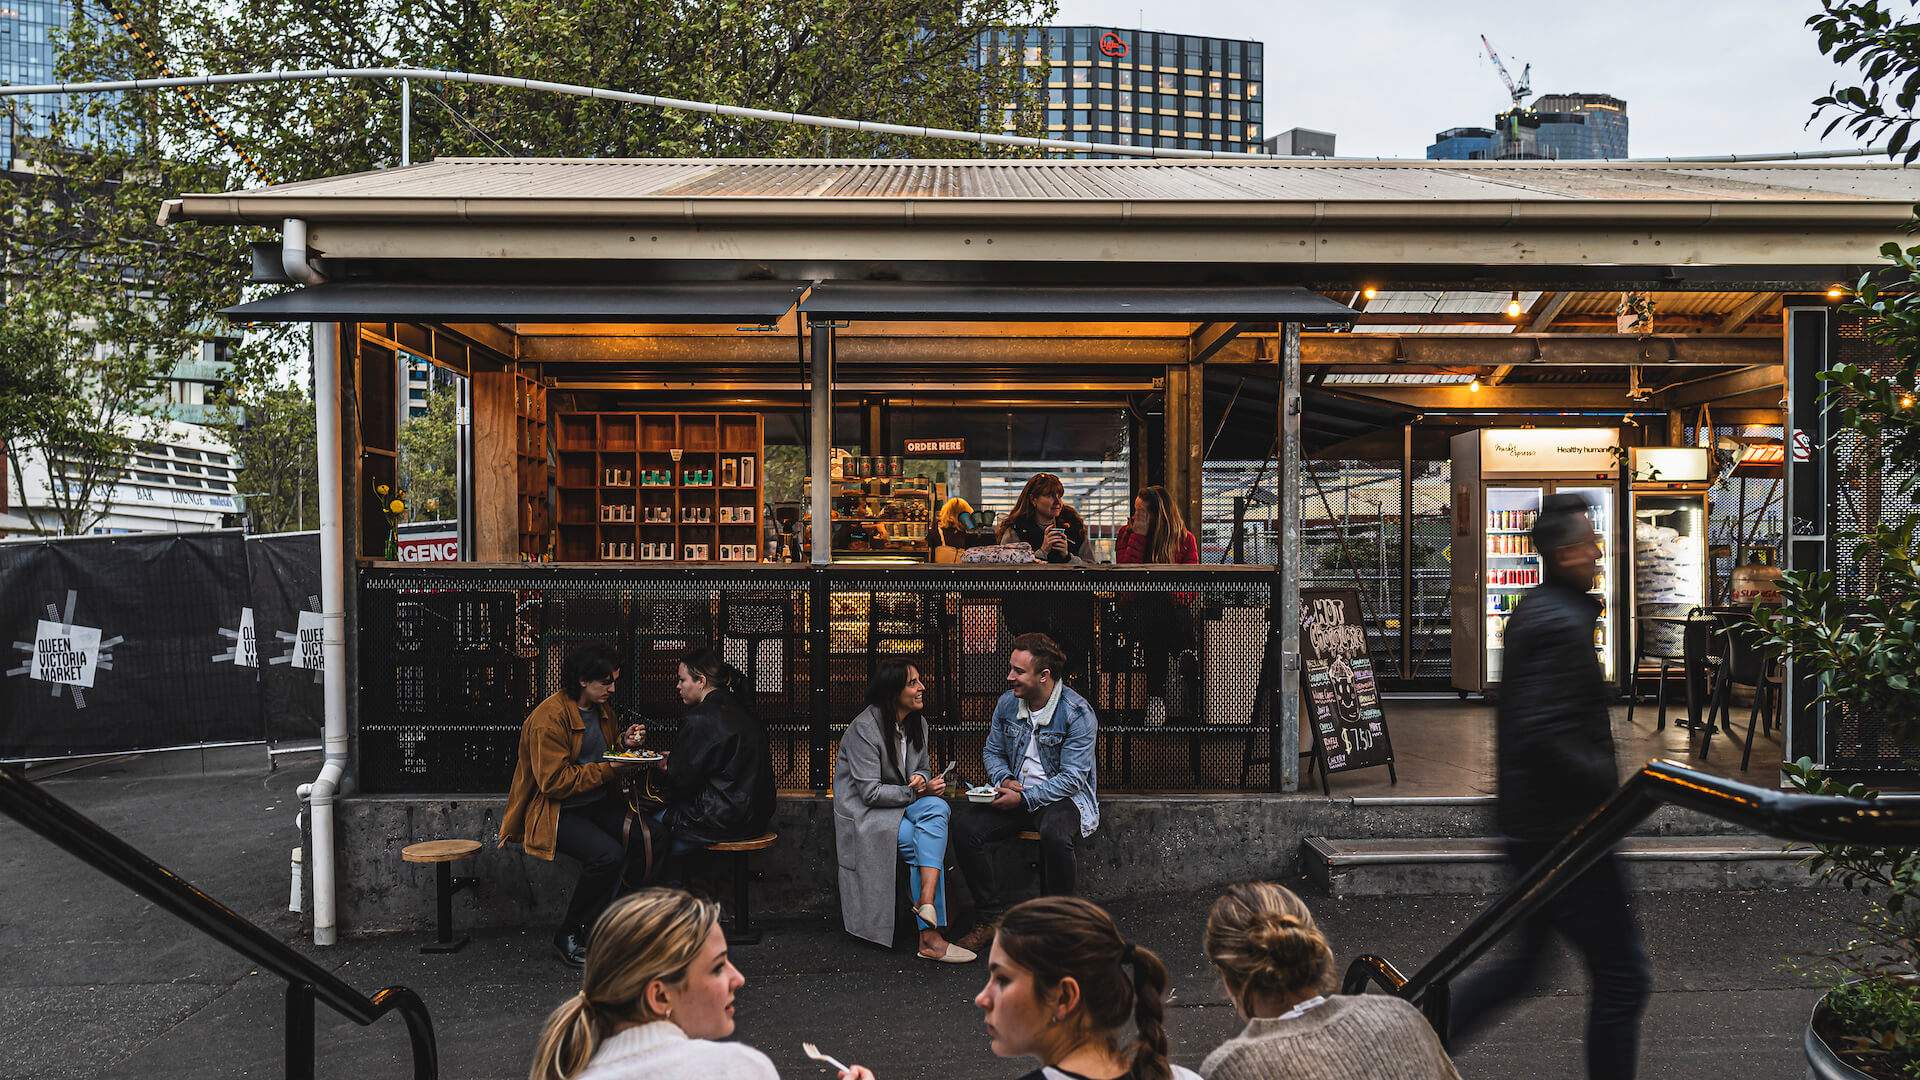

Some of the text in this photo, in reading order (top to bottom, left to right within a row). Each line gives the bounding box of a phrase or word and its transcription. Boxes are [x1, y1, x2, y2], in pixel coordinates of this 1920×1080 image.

[907, 441, 961, 452] ORDER HERE
[1557, 446, 1583, 454] Healthy
[136, 487, 154, 501] BAR
[171, 490, 205, 506] LOUNGE
[1313, 599, 1344, 626] HOT
[38, 637, 72, 654] QUEEN
[39, 650, 87, 668] VICTORIA
[40, 665, 82, 682] MARKET
